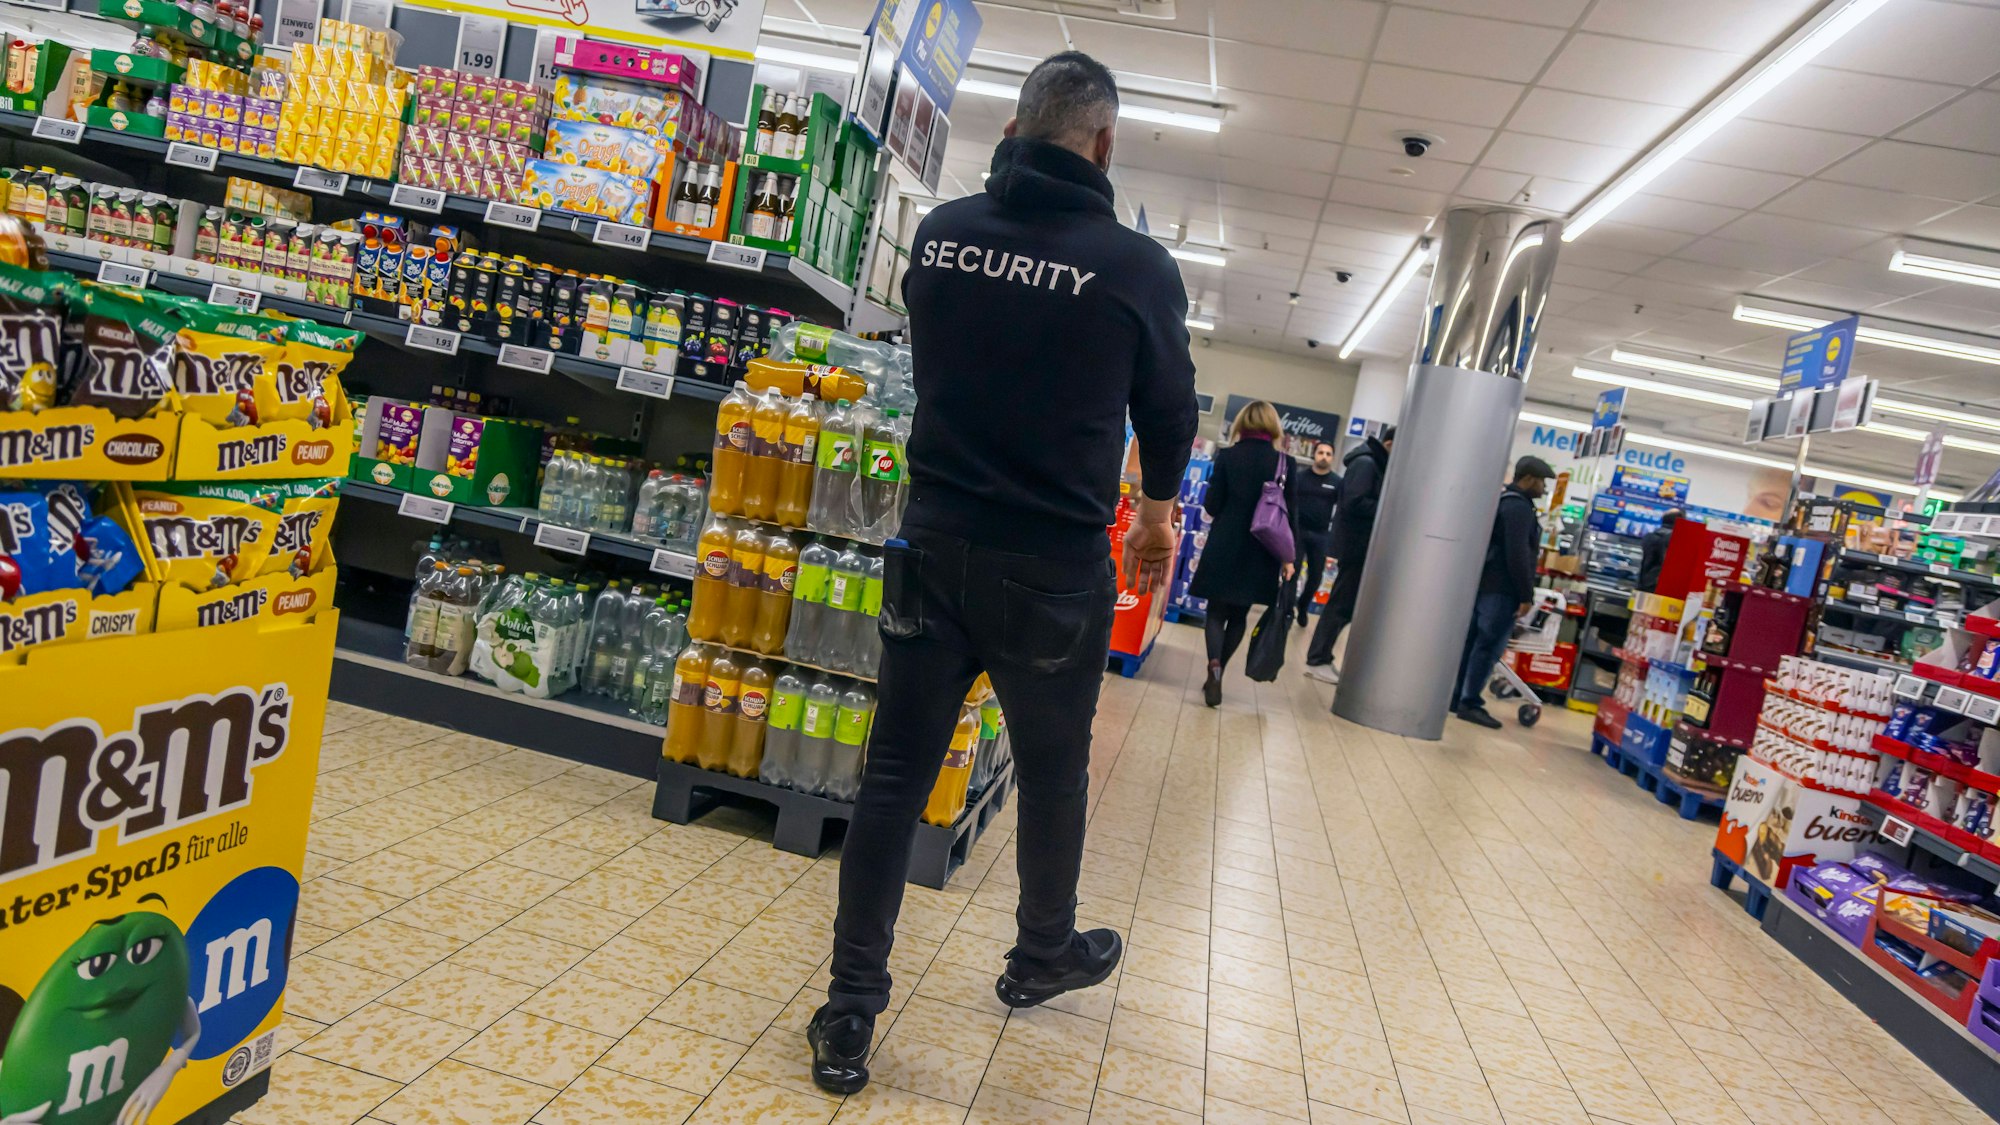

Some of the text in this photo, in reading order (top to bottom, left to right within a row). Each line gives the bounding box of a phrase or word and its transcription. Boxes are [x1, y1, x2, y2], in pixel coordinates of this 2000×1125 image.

[281, 17, 314, 30] EINWEG
[462, 50, 494, 69] 1.99
[538, 63, 558, 80] 1.9
[60, 127, 76, 137] 1.99
[194, 153, 209, 164] 1.19
[577, 138, 622, 163] Orange
[323, 178, 339, 188] 1.39
[555, 177, 598, 203] Orange
[419, 195, 437, 207] 1.99
[515, 213, 532, 224] 1.39
[623, 232, 642, 244] 1.49
[739, 253, 757, 264] 1.39
[921, 240, 1096, 296] SECURITY
[125, 273, 140, 284] 1.48
[235, 296, 253, 307] 2.68
[98, 326, 134, 343] CHOCOLAT
[215, 322, 236, 334] MAXI
[435, 337, 452, 347] 1.93
[1280, 412, 1324, 437] hriften
[106, 441, 160, 459] CHOCOLATE
[452, 437, 474, 447] vitamin
[1531, 426, 1685, 473] Me eude
[297, 445, 330, 461] PEANUT
[198, 485, 251, 504] MAXI 400g
[269, 511, 322, 556] &m's
[278, 593, 311, 610] PEANUT
[92, 612, 136, 635] CRISPY
[1731, 779, 1764, 804] bueno
[1804, 815, 1891, 846] bueno
[84, 841, 181, 900] Spaß
[185, 834, 215, 865] für
[217, 821, 249, 853] alle
[198, 917, 273, 1014] m
[58, 1037, 130, 1115] m
